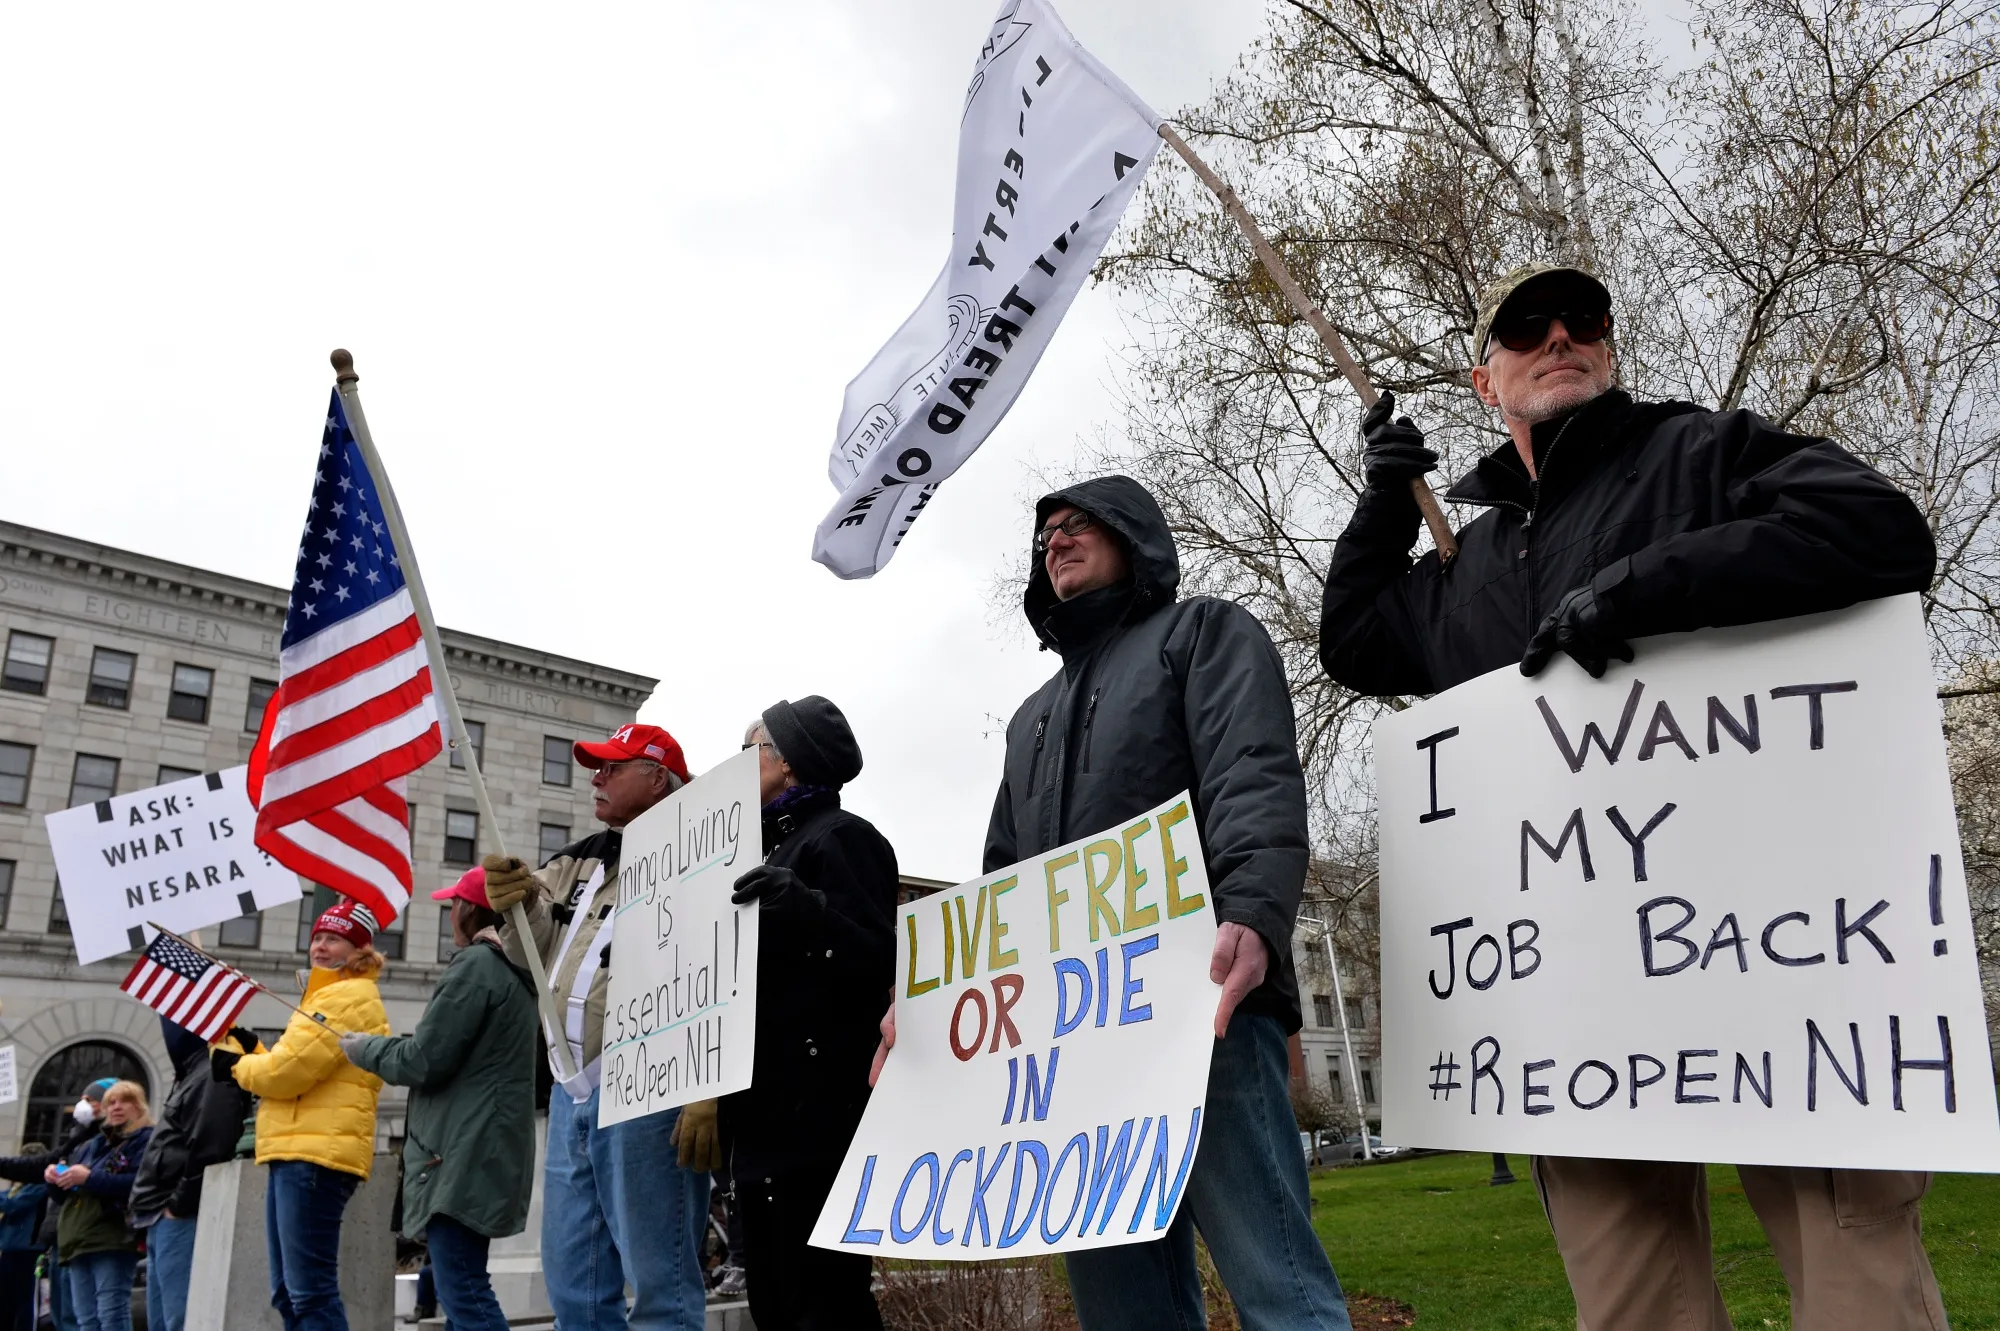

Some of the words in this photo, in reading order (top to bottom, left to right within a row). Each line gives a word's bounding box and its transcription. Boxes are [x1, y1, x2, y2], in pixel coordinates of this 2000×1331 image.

[85, 595, 231, 642] EIGHTEEN
[484, 683, 562, 713] THIRTY
[1416, 725, 1460, 824] I
[1535, 679, 1858, 773] WANT
[102, 827, 184, 867] WHAT
[209, 818, 234, 841] IS
[129, 795, 195, 826] ASK:
[661, 843, 672, 881] a
[678, 800, 741, 876] Living
[1520, 803, 1677, 891] MY
[126, 860, 245, 908] NESARA
[657, 895, 672, 940] is
[906, 874, 1018, 999] LIVE
[1044, 800, 1206, 953] FREE
[949, 973, 1024, 1062] OR
[1053, 933, 1159, 1039] DIE
[1428, 916, 1542, 1000] JOB
[1001, 1046, 1060, 1126] IN
[840, 1106, 1201, 1250] LOCKDOWN
